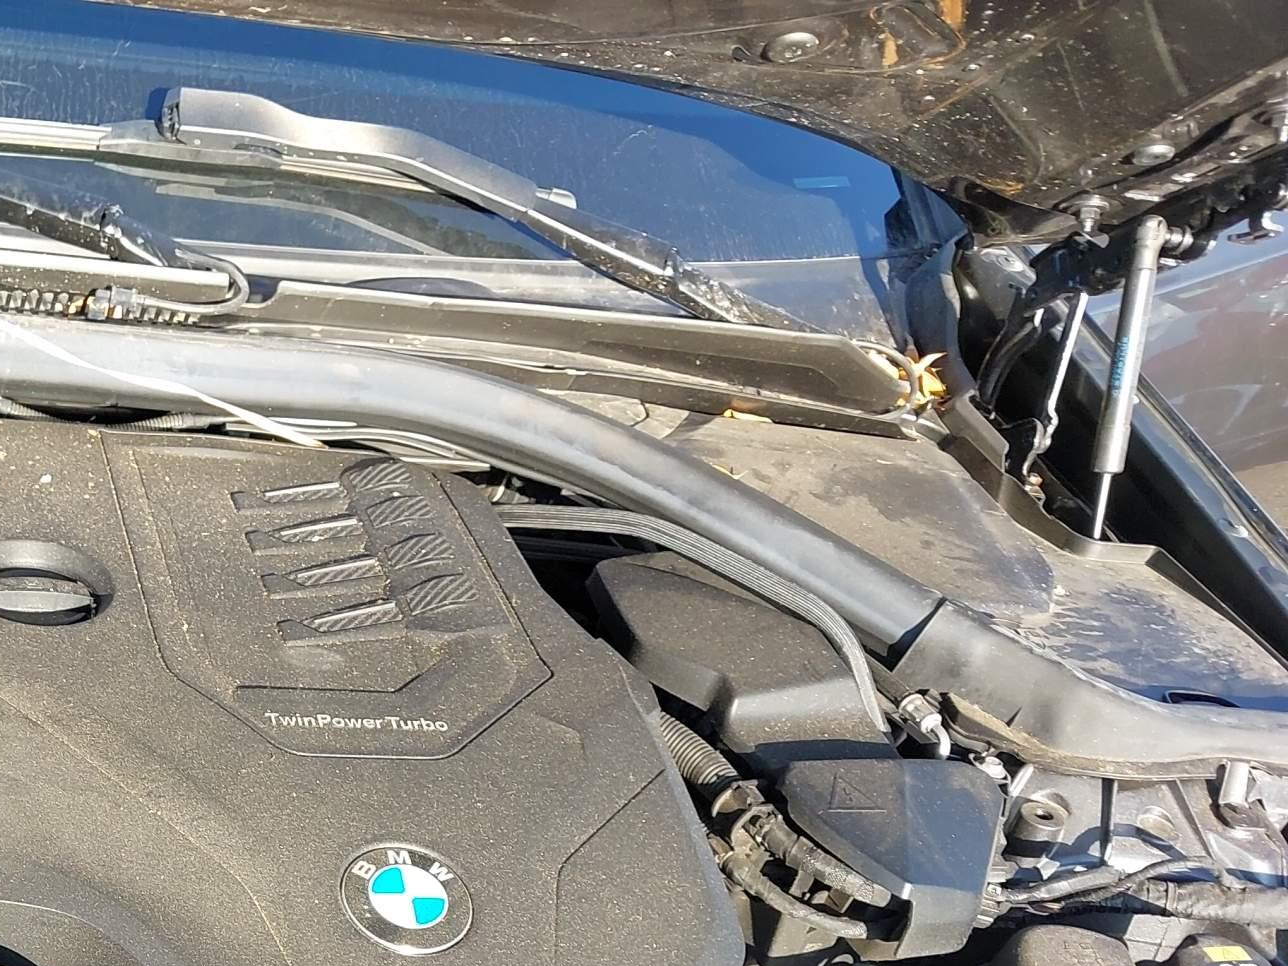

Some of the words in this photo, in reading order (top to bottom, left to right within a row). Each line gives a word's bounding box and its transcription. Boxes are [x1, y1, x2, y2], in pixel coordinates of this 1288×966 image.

[265, 711, 383, 730] TwinPower
[384, 715, 449, 732] Turbo
[351, 850, 455, 882] BMW
